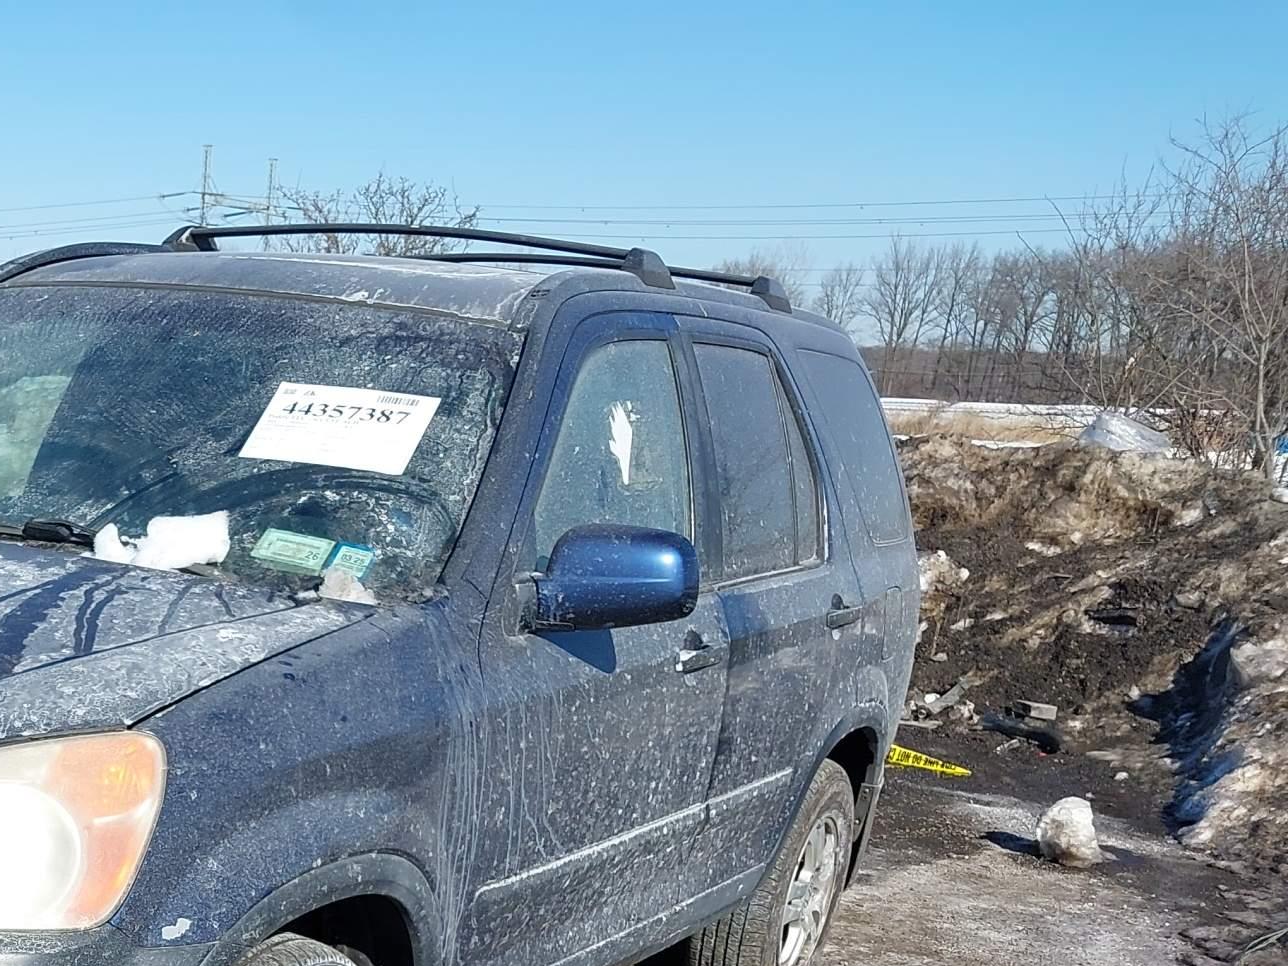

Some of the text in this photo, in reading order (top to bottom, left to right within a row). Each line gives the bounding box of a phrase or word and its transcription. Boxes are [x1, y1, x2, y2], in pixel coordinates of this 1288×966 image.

[282, 402, 411, 425] 44357387
[304, 550, 320, 561] 26
[896, 751, 910, 762] NOT
